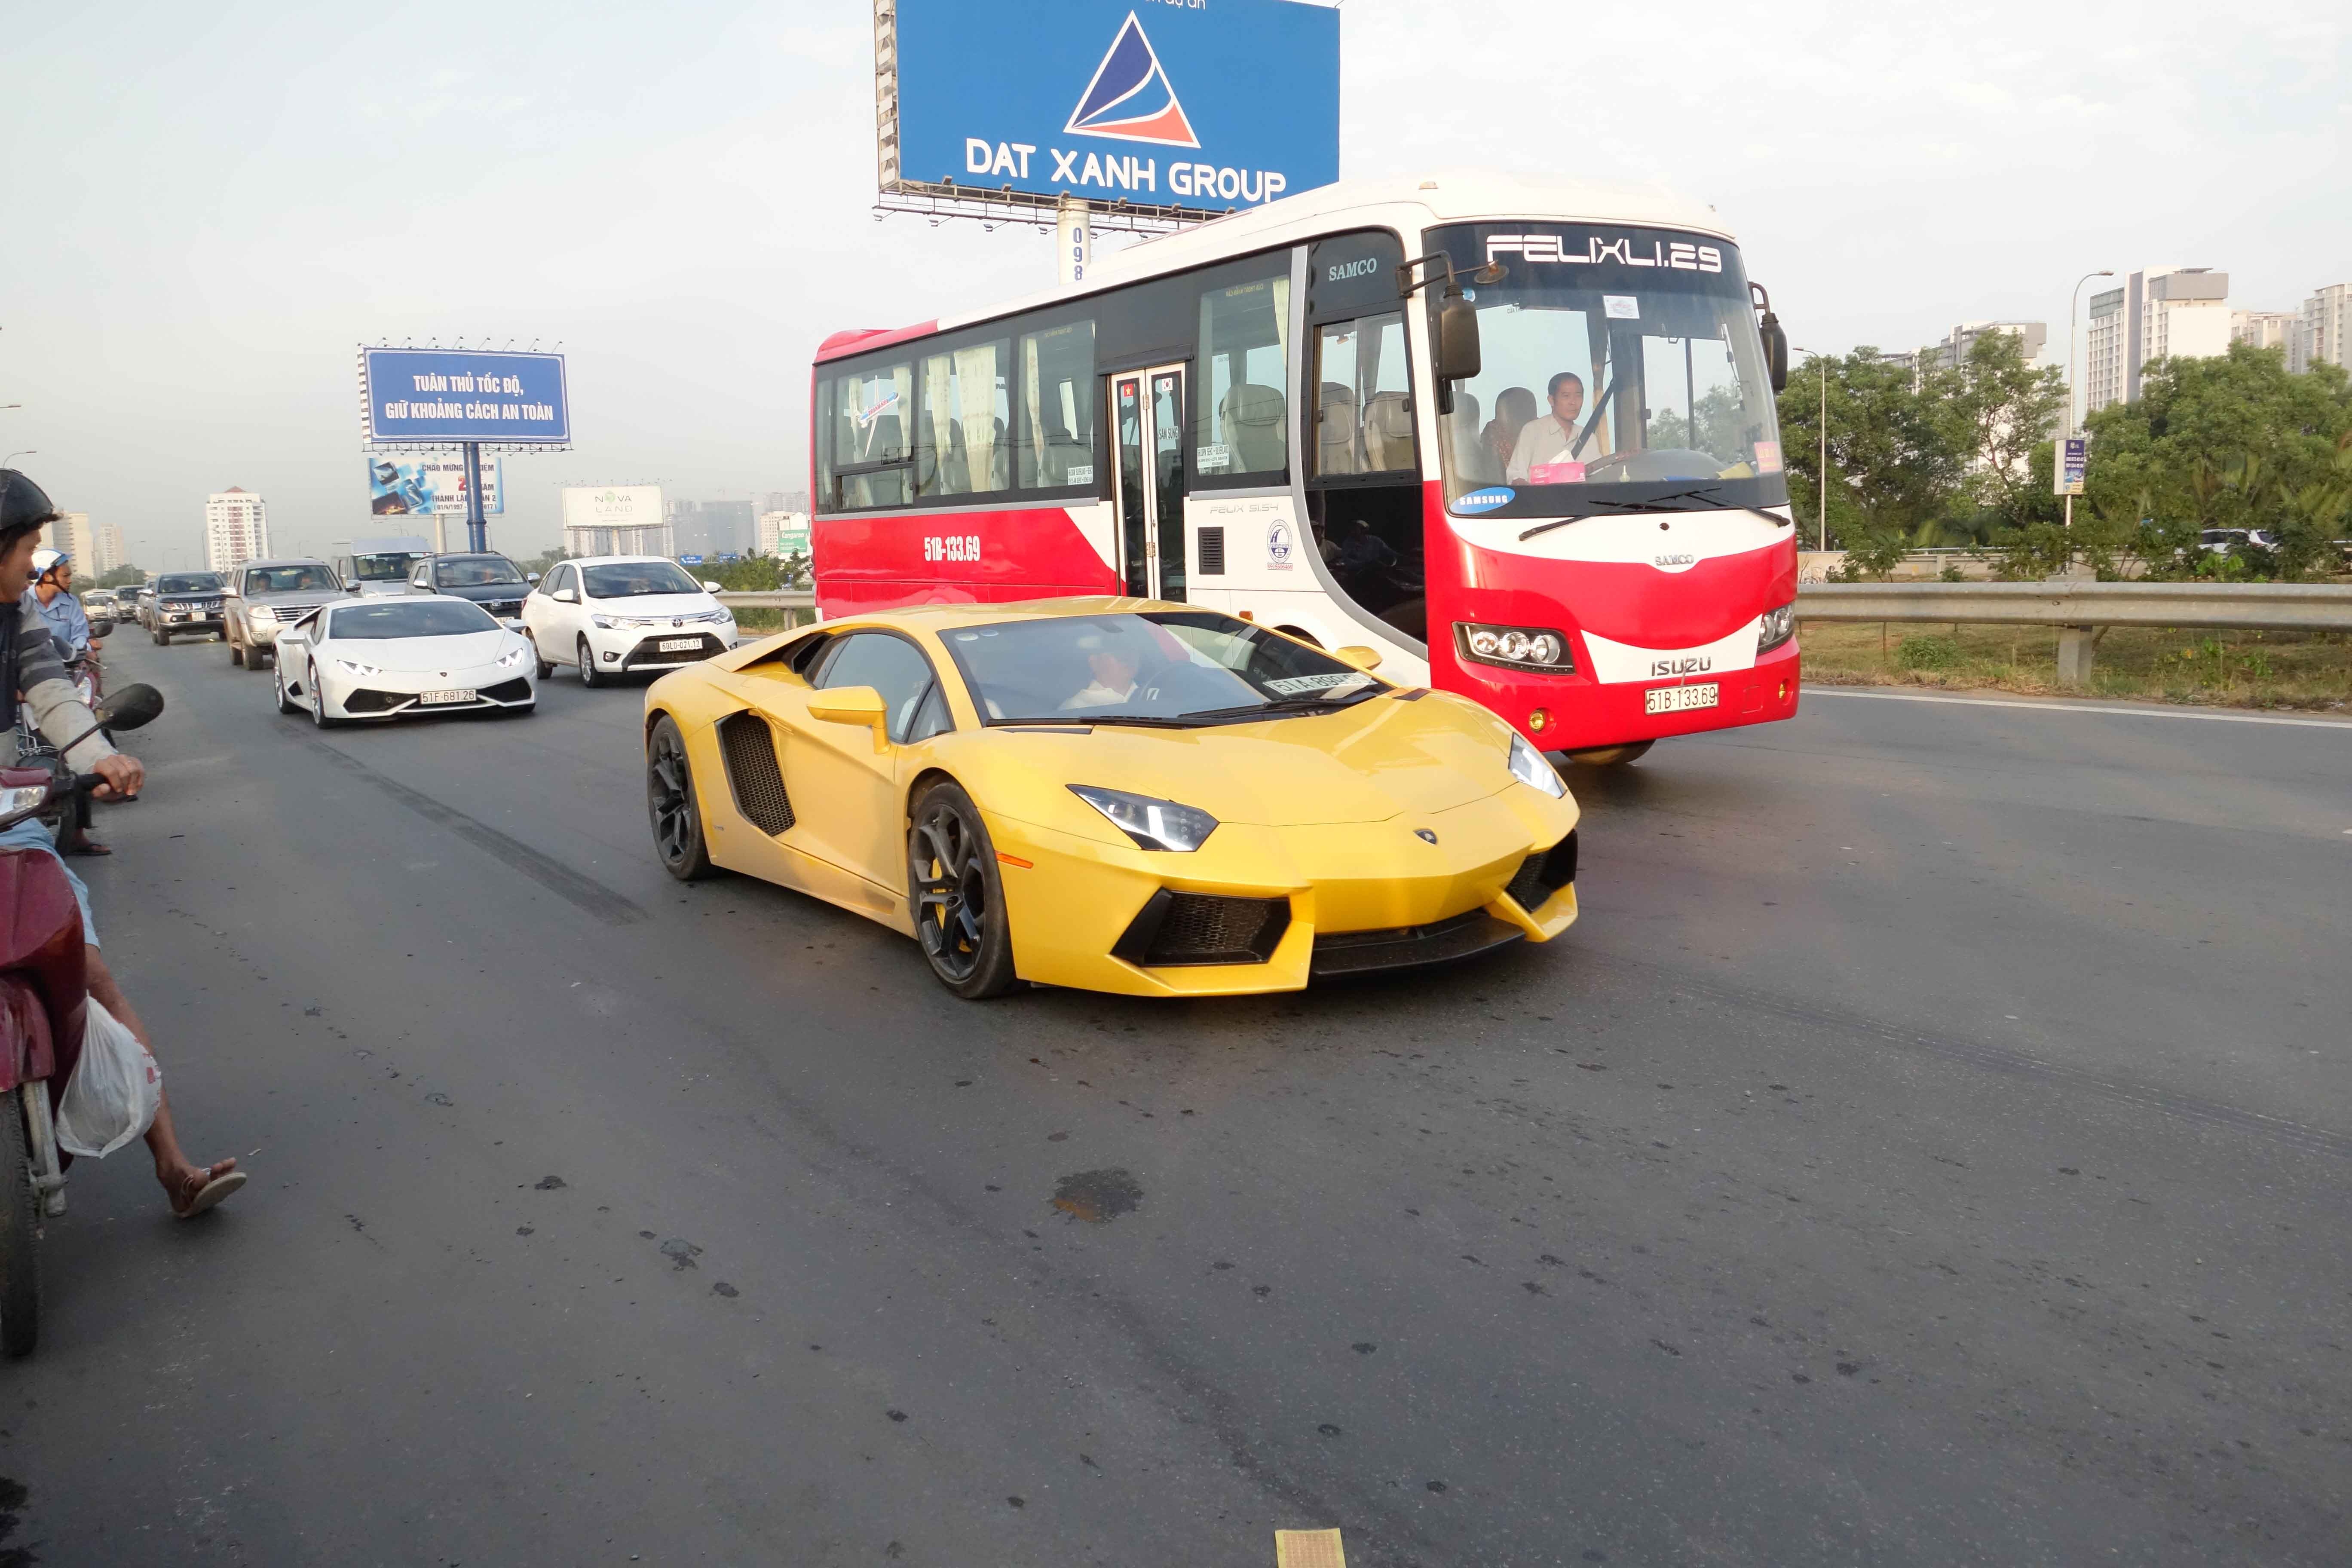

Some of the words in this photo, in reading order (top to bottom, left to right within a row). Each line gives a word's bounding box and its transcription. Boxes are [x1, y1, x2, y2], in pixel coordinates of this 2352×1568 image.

[965, 138, 1036, 178] DAT
[1050, 148, 1155, 192] XANH
[1169, 161, 1286, 203] GROUP
[1329, 258, 1377, 281] SAMCO
[413, 373, 449, 392] TUÂN
[450, 371, 474, 392] THỦ
[477, 372, 500, 393] TỐC
[503, 375, 524, 397] ĐỘ,
[386, 399, 409, 419] GIỮ
[410, 398, 462, 419] KHOẢNG
[466, 401, 499, 420] CÁCH
[502, 404, 519, 420] AN
[522, 402, 554, 420] TOÀN
[1459, 495, 1508, 505] SAMSUNG
[924, 536, 980, 561] 51B-133.69
[1655, 554, 1694, 566] SAMCO
[1651, 656, 1712, 677] ISUZU
[423, 690, 475, 702] 51F-681.26
